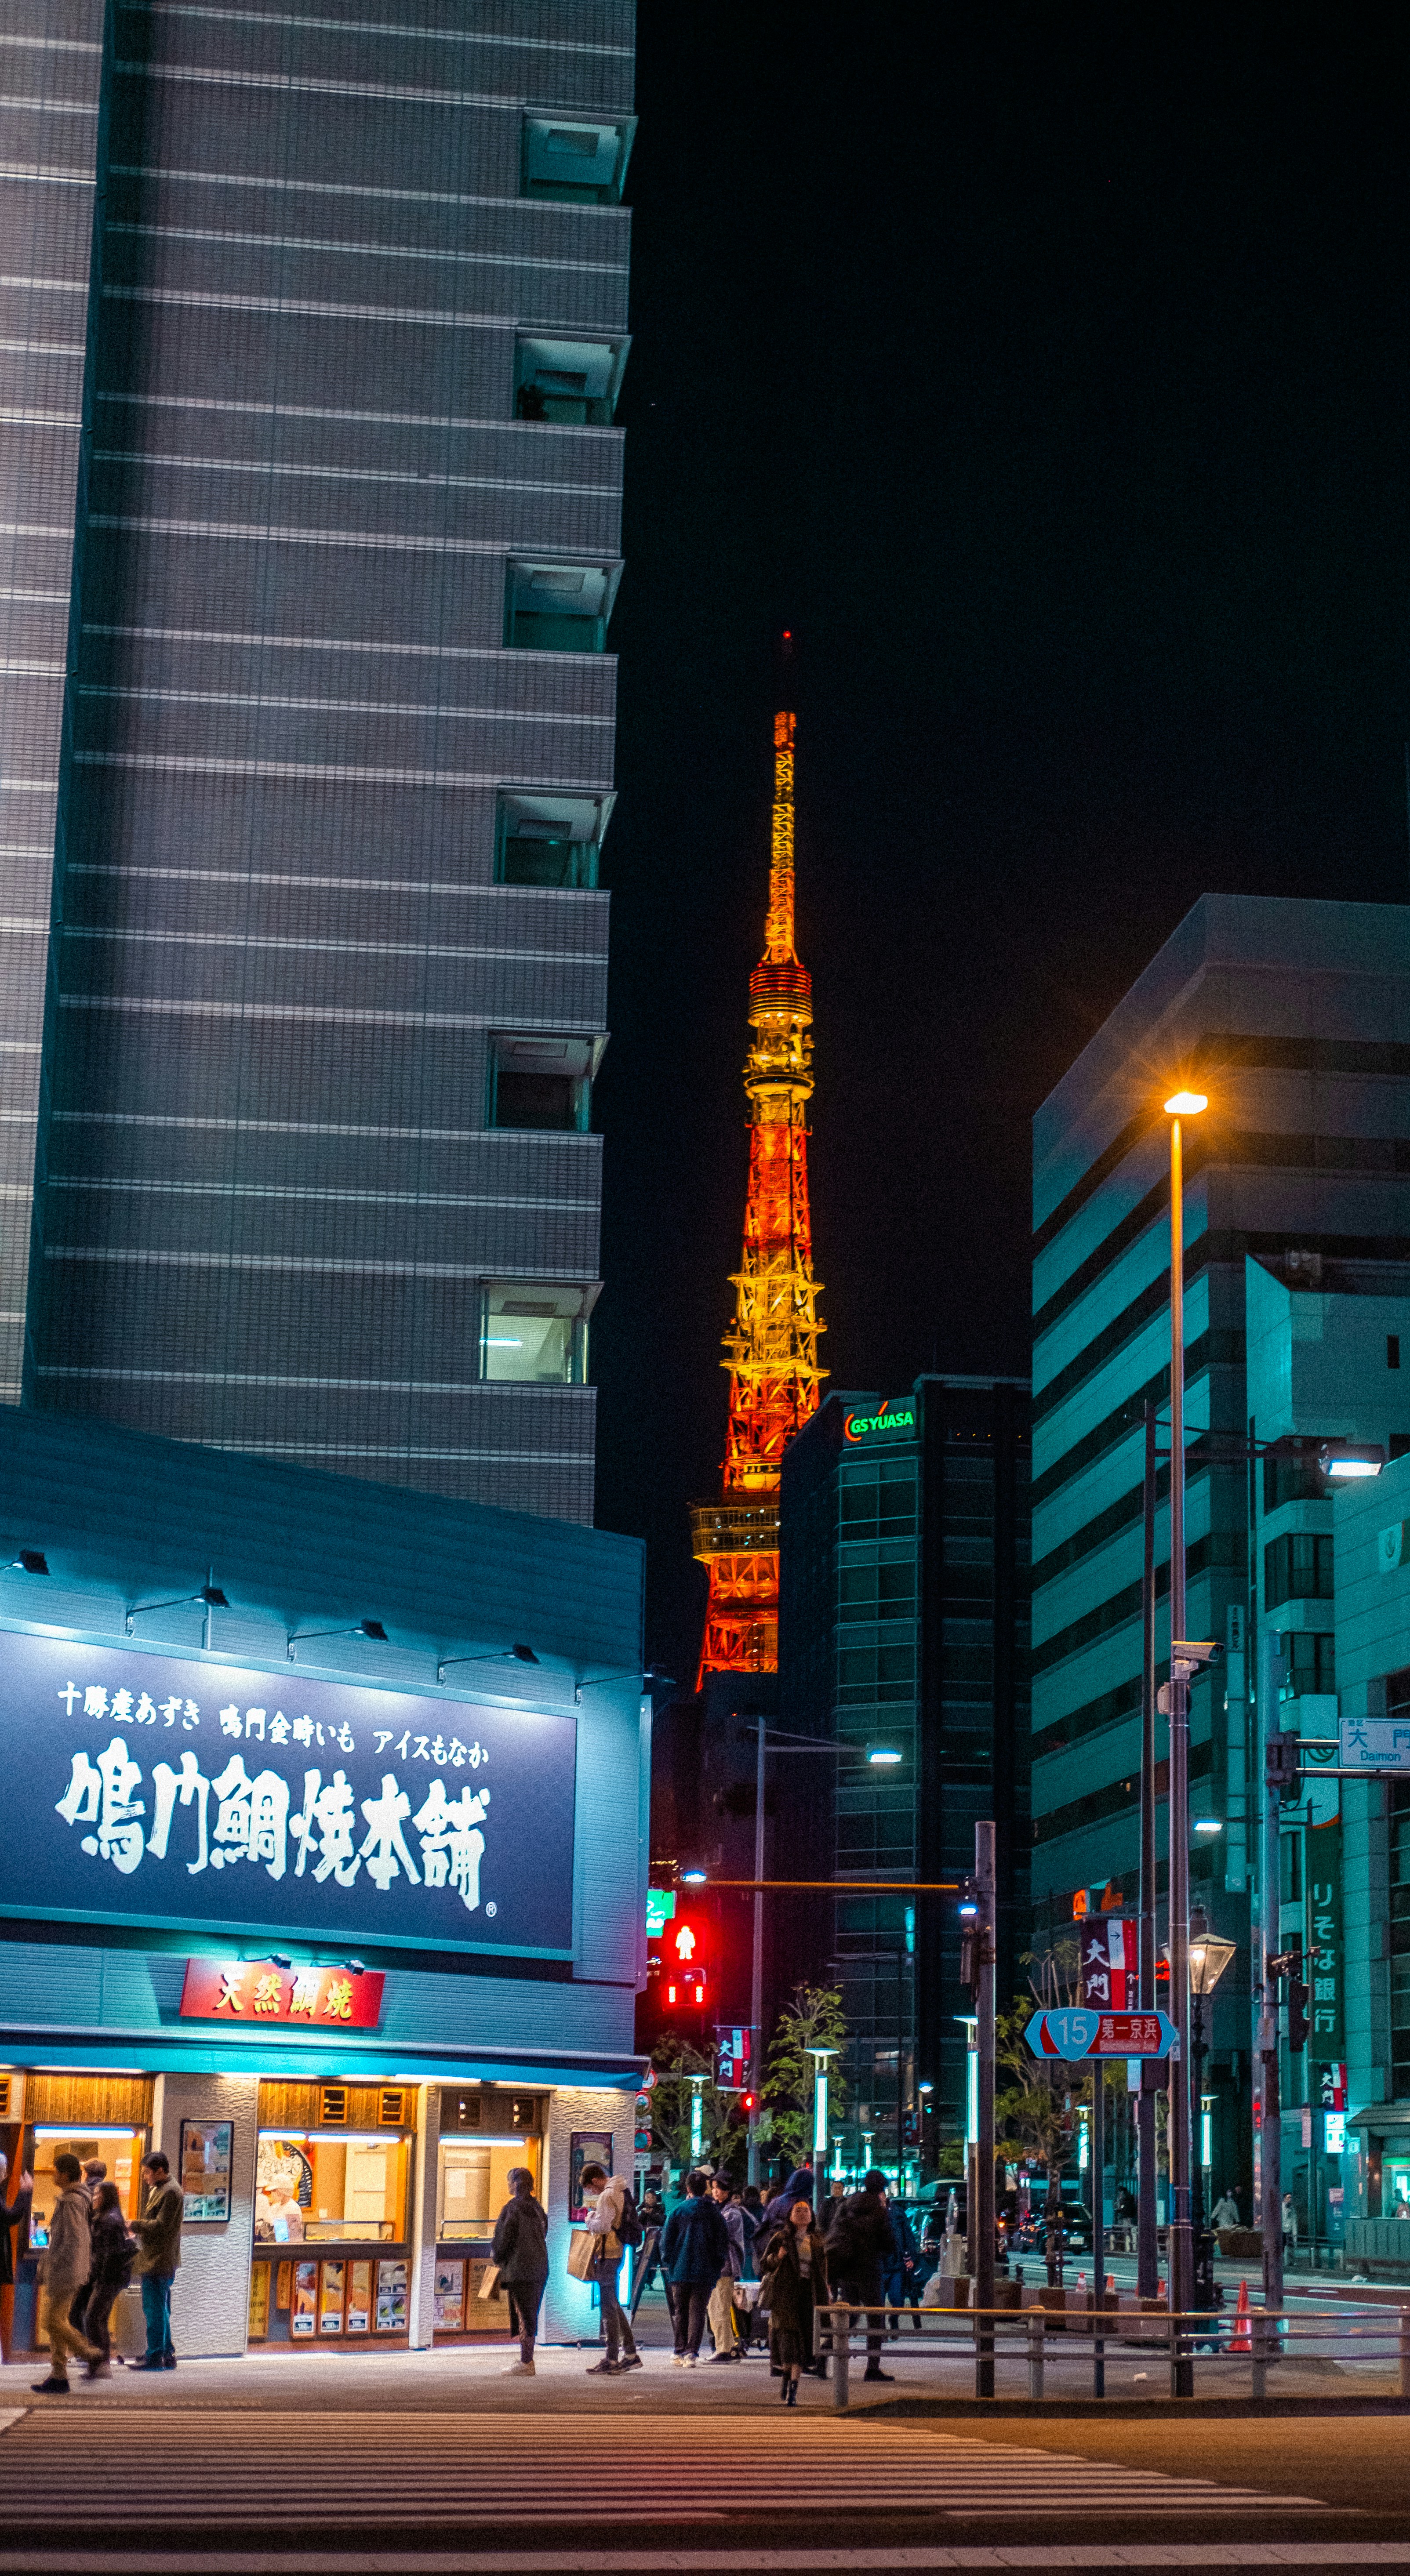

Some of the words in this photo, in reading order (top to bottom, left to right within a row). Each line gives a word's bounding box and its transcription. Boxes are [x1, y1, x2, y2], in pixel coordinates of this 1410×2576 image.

[58, 1681, 200, 1731] 十勝産あずき
[220, 1704, 355, 1752] 鳴門金時いも
[373, 1730, 489, 1769] アイスもなか
[1360, 1750, 1401, 1761] Daimon
[55, 1737, 490, 1910] 鳴門鯛焼本舗
[1083, 1939, 1110, 2001] 大門
[1313, 1883, 1336, 2033] りそな銀行
[213, 1973, 353, 2019] 天然鯛焼
[1058, 2016, 1088, 2045] 15
[1101, 2018, 1157, 2039] 第一京浜
[717, 2040, 734, 2078] 大門
[1319, 2072, 1335, 2104] 大門
